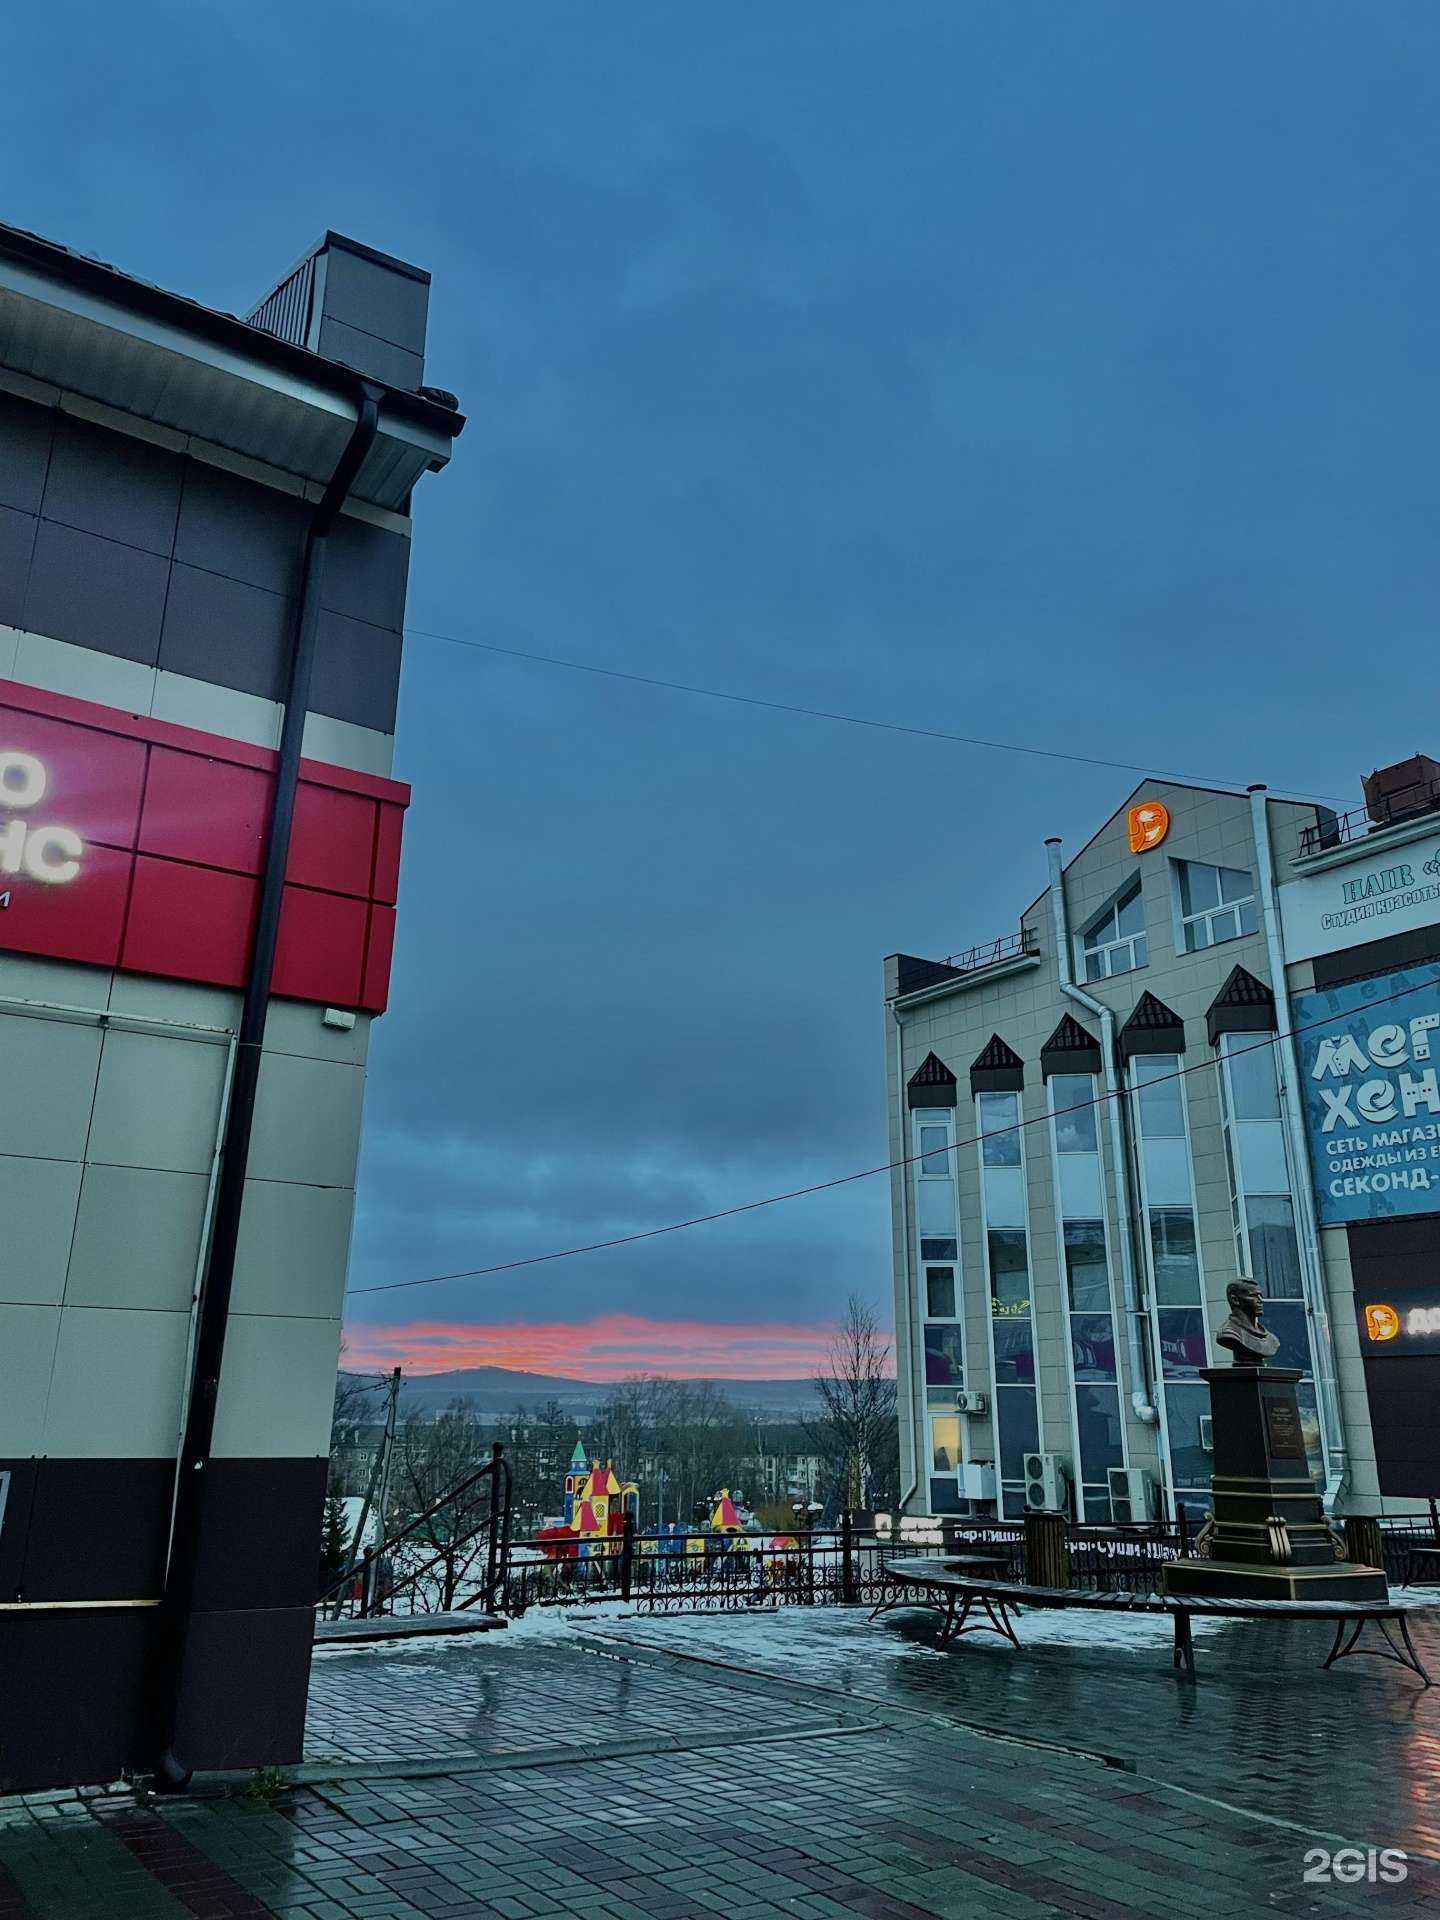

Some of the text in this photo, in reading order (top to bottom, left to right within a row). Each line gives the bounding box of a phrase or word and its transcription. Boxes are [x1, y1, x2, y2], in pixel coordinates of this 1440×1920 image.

[1325, 1136, 1368, 1156] СЕТЬ
[1328, 1151, 1401, 1173] ОДЕЖДЫ
[1404, 1147, 1427, 1163] ИЗ
